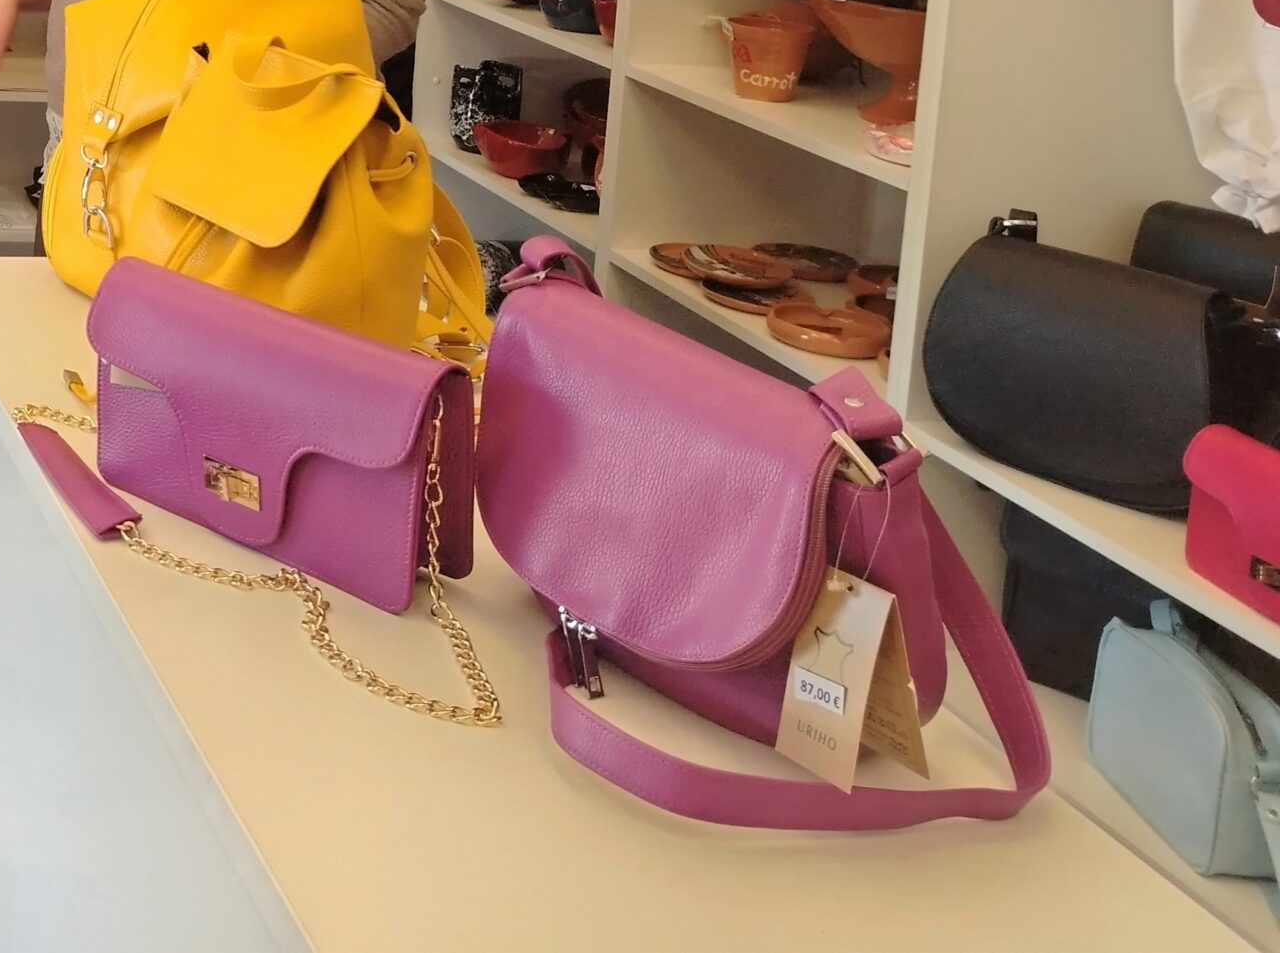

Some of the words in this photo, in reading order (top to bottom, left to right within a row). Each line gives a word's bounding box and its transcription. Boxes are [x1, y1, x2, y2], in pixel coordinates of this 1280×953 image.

[800, 679, 831, 704] 87,00
[833, 696, 841, 709] €
[797, 719, 838, 751] URIHO
